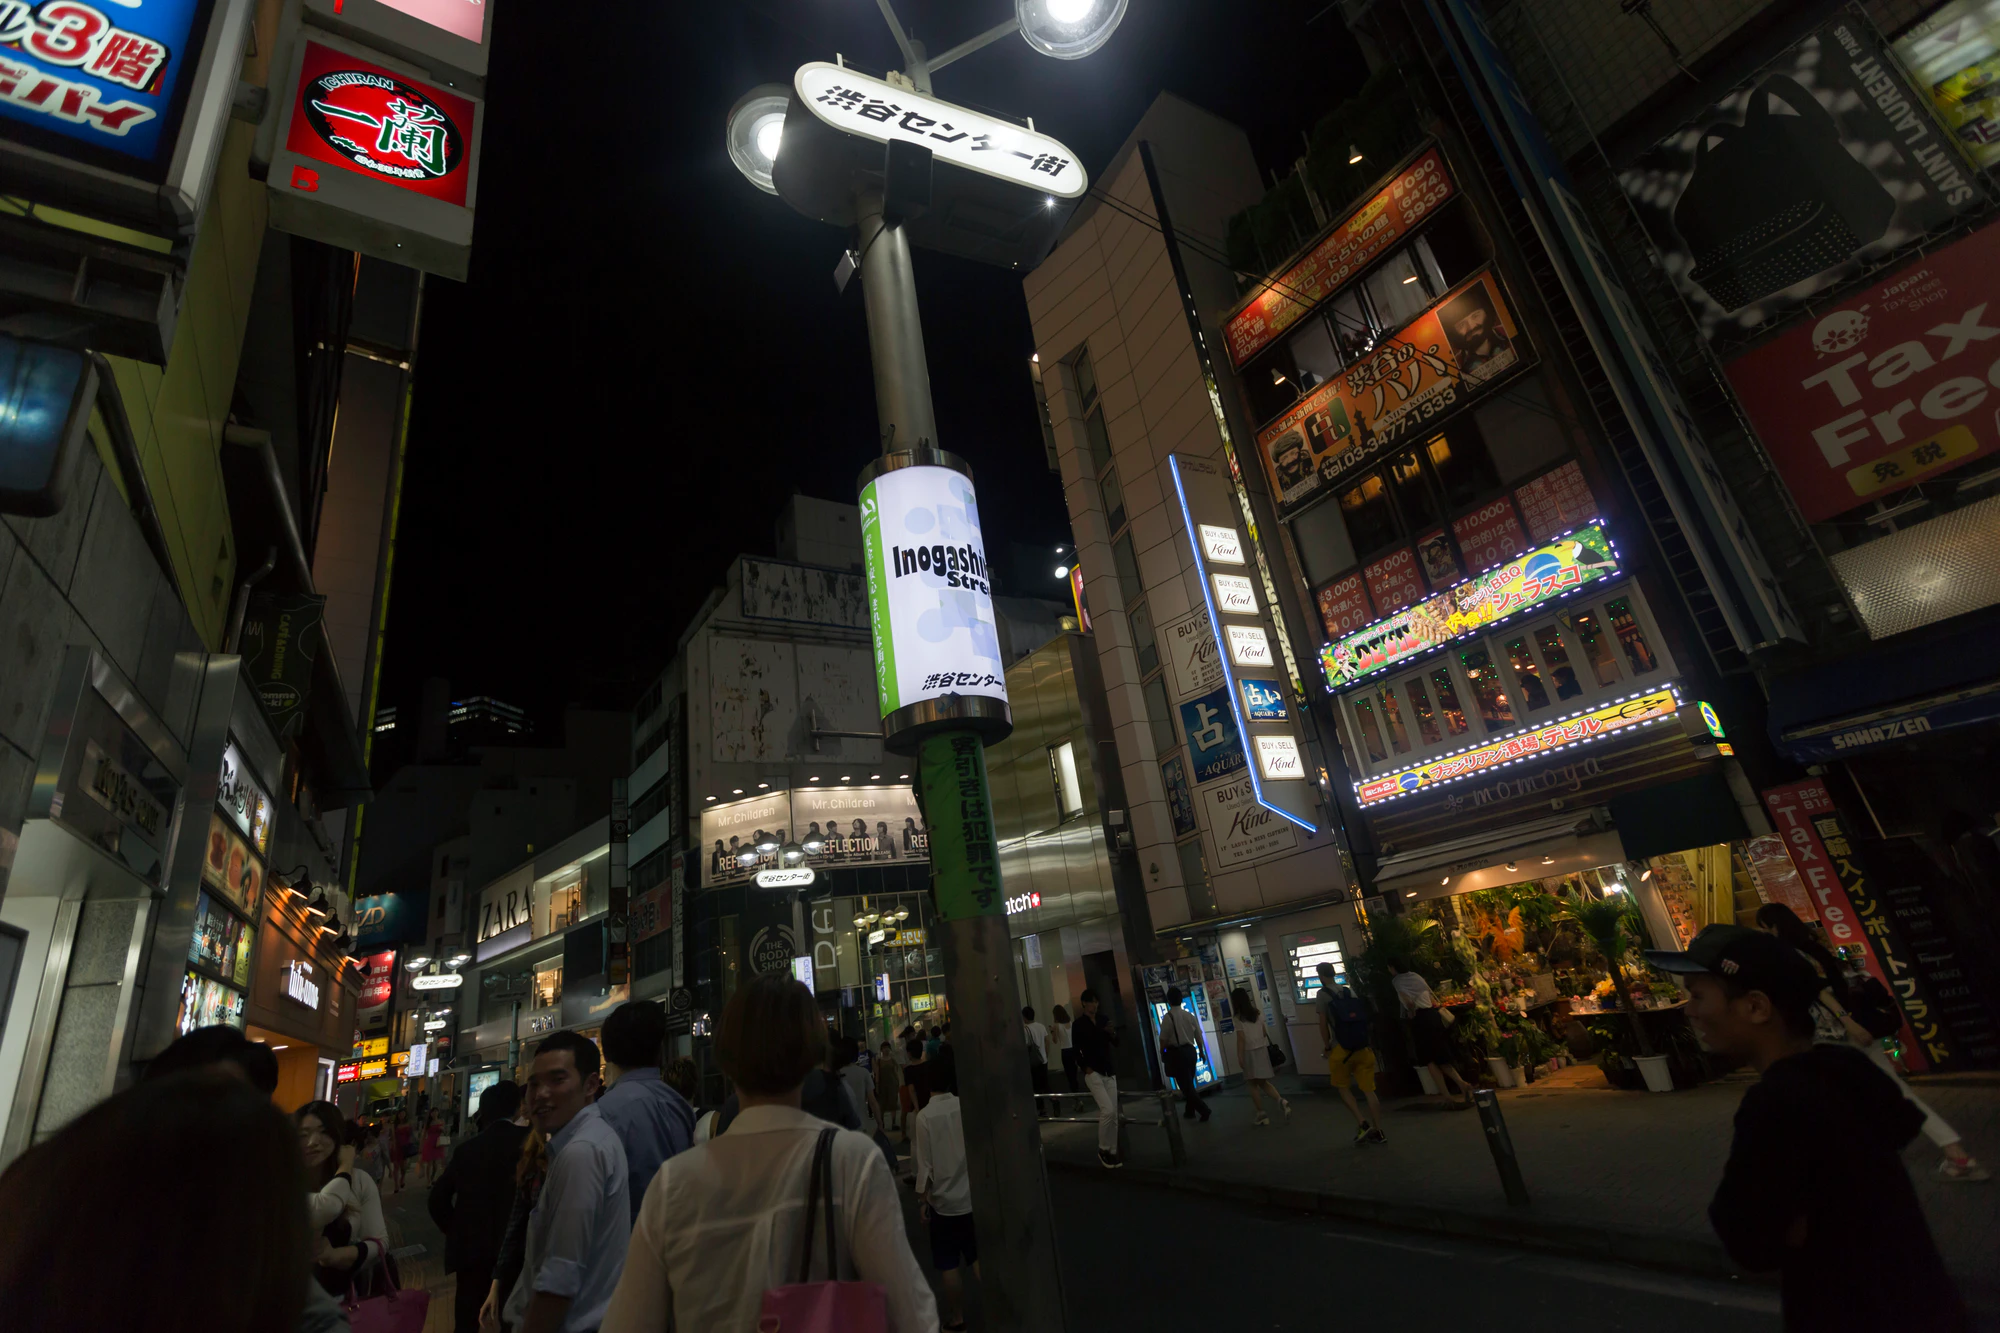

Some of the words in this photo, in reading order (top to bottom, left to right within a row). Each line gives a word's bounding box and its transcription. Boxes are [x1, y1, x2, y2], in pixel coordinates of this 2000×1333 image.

[1833, 25, 1863, 58] PARIS
[318, 71, 395, 92] ICHIRAN
[1850, 55, 1929, 146] LAURENT
[311, 97, 447, 176] 一蘭
[816, 85, 1070, 177] 渋谷センター街
[1404, 158, 1435, 189] 090
[1912, 143, 1974, 206] SAINT
[1398, 171, 1442, 211] (6474)
[1403, 183, 1448, 224] 3933
[1880, 277, 1942, 313] Tax-free
[1908, 287, 1949, 312] Shop
[1347, 342, 1415, 398] 渋谷の
[1801, 302, 2000, 407] Tax
[1372, 343, 1448, 421] パパ
[1311, 408, 1346, 441] 占い
[1382, 405, 1407, 425] AMIN
[1811, 356, 2000, 469] Fre
[1323, 387, 1457, 481] tel.03-3477-1333
[1872, 441, 1947, 483] 免税
[1220, 532, 1235, 540] SELL
[1474, 536, 1516, 566] 40分
[1233, 581, 1249, 589] SELL
[1382, 583, 1418, 611] 20分
[1459, 564, 1523, 609] ブラジルBBQ
[1492, 564, 1582, 613] シュラスコ
[1177, 619, 1198, 638] BUY
[1232, 631, 1244, 639] BUY
[1248, 632, 1263, 640] SELL
[1186, 634, 1217, 670] Kin
[1354, 624, 1421, 670] DEVIL
[1248, 684, 1281, 706] 占い
[1261, 742, 1274, 750] BUY
[1278, 742, 1294, 750] SELL
[1428, 734, 1540, 781] ブラジリアン酒場
[1542, 716, 1603, 746] デビル
[1216, 785, 1239, 804] BUY
[1473, 757, 1605, 807] momoya
[1797, 787, 1826, 800] B2F
[717, 806, 776, 828] Mr.Children
[811, 798, 876, 811] Mr.Children
[1803, 798, 1830, 810] B1F
[951, 735, 997, 909] 客引きは犯罪です
[1776, 805, 1819, 862] Tax
[1806, 866, 1853, 939] Free
[481, 885, 532, 940] ZARA
[759, 947, 791, 962] BODY
[765, 940, 783, 950] THE
[761, 959, 790, 972] SHOP
